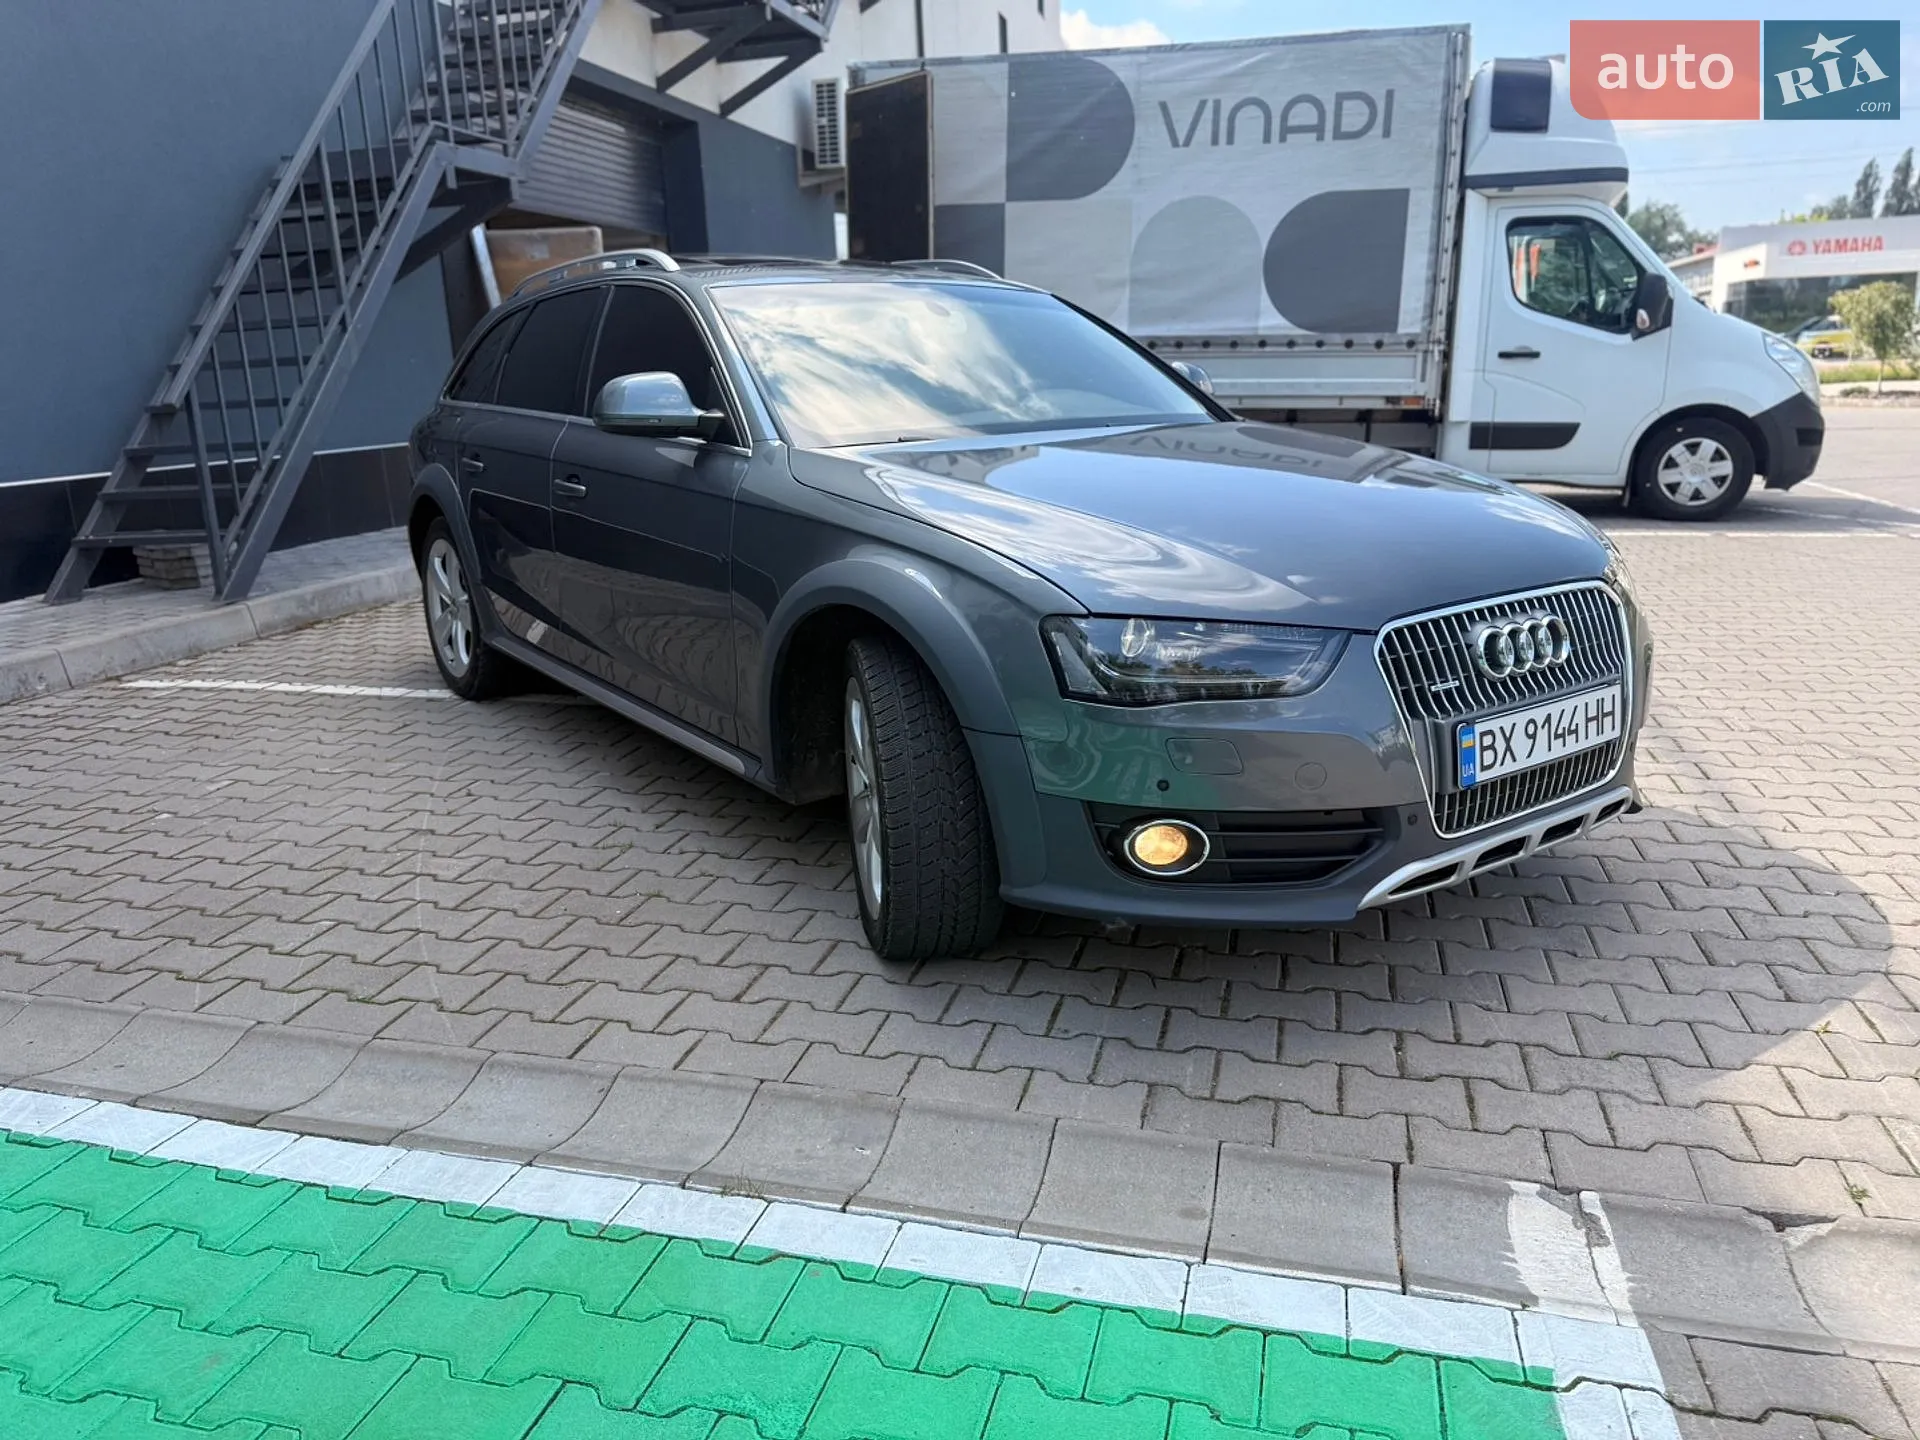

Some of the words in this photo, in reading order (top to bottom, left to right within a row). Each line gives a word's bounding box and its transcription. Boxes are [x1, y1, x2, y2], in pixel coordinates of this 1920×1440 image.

[1158, 89, 1395, 148] VINADI
[1812, 236, 1884, 255] YAMAHA
[1479, 722, 1517, 772] BX
[1524, 705, 1579, 759] 9144
[1585, 694, 1616, 740] HH
[1462, 763, 1474, 778] UA
